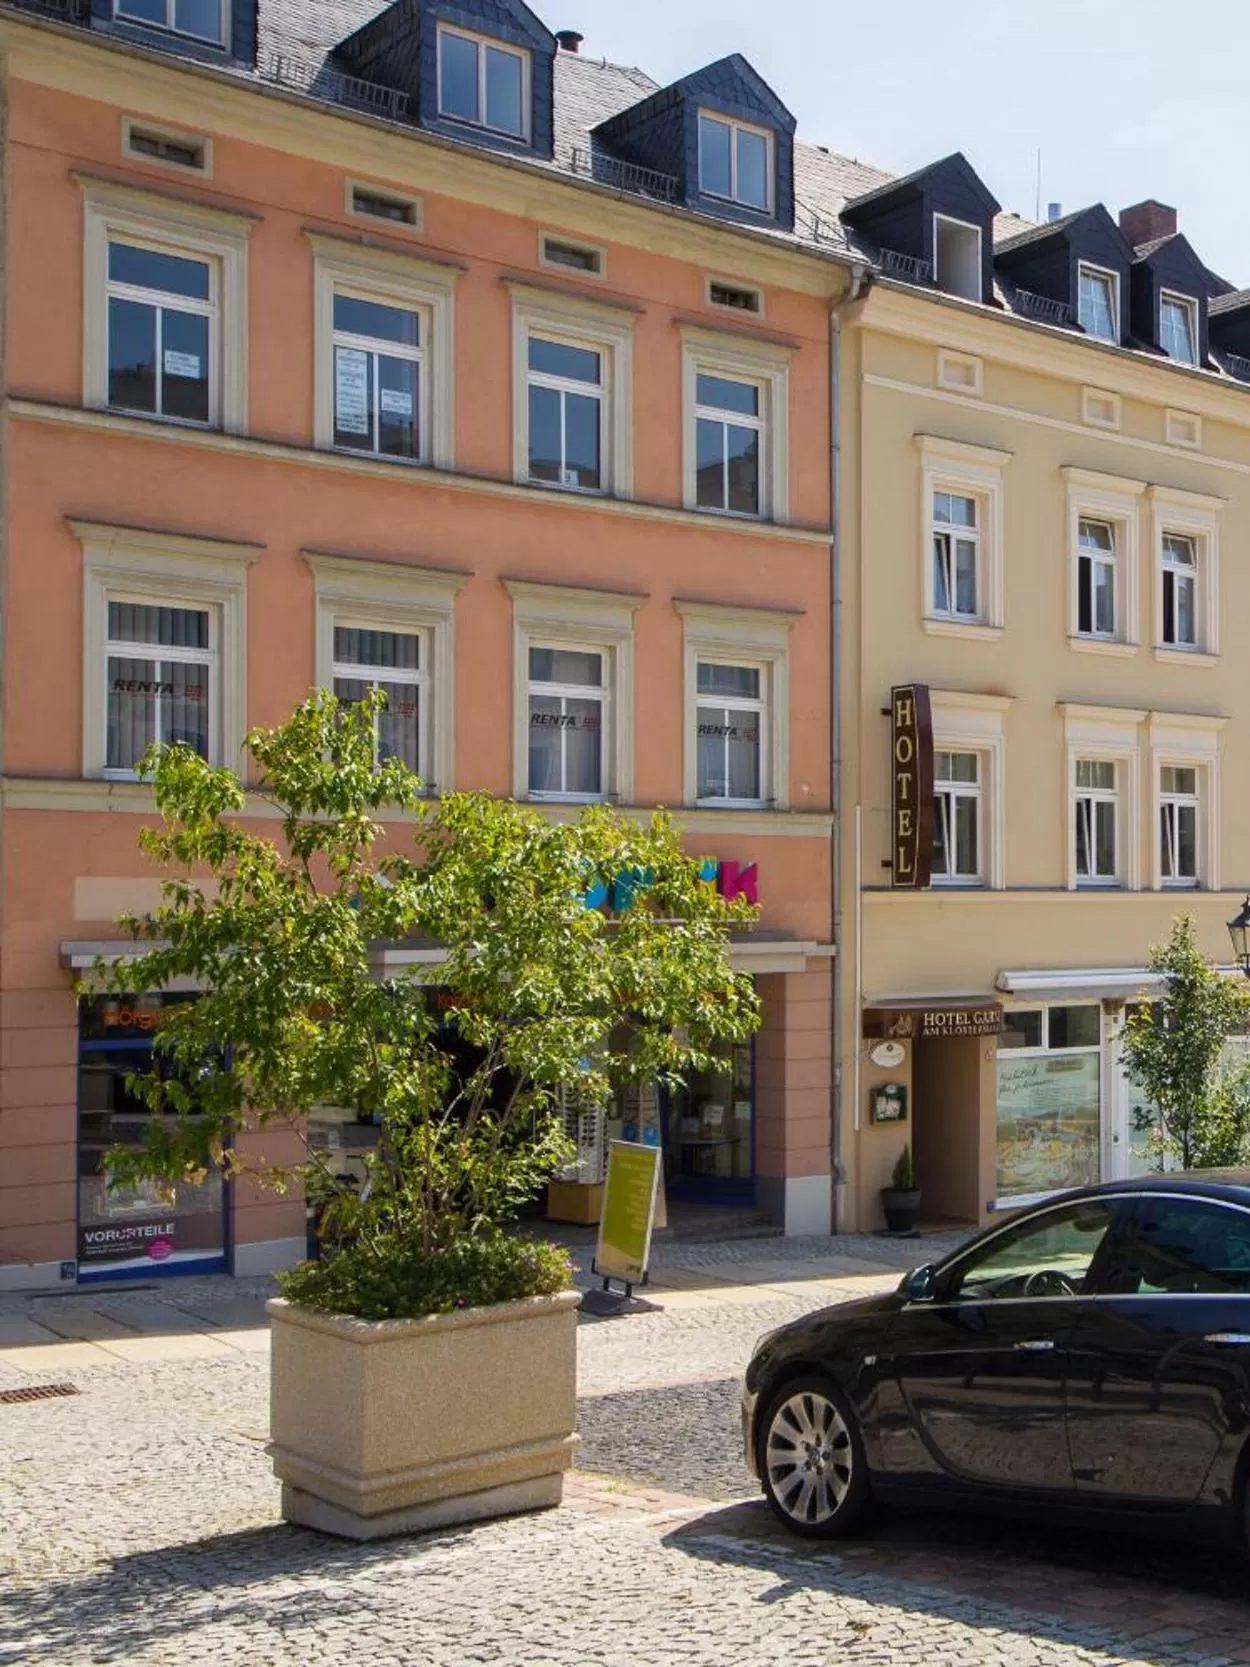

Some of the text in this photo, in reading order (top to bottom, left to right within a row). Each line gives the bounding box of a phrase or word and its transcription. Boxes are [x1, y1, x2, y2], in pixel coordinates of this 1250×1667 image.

[113, 679, 173, 694] RENTA
[531, 713, 576, 726] RENTA
[896, 700, 913, 873] HOTEL
[923, 1012, 971, 1027] HOTEL
[922, 1027, 940, 1036] AM
